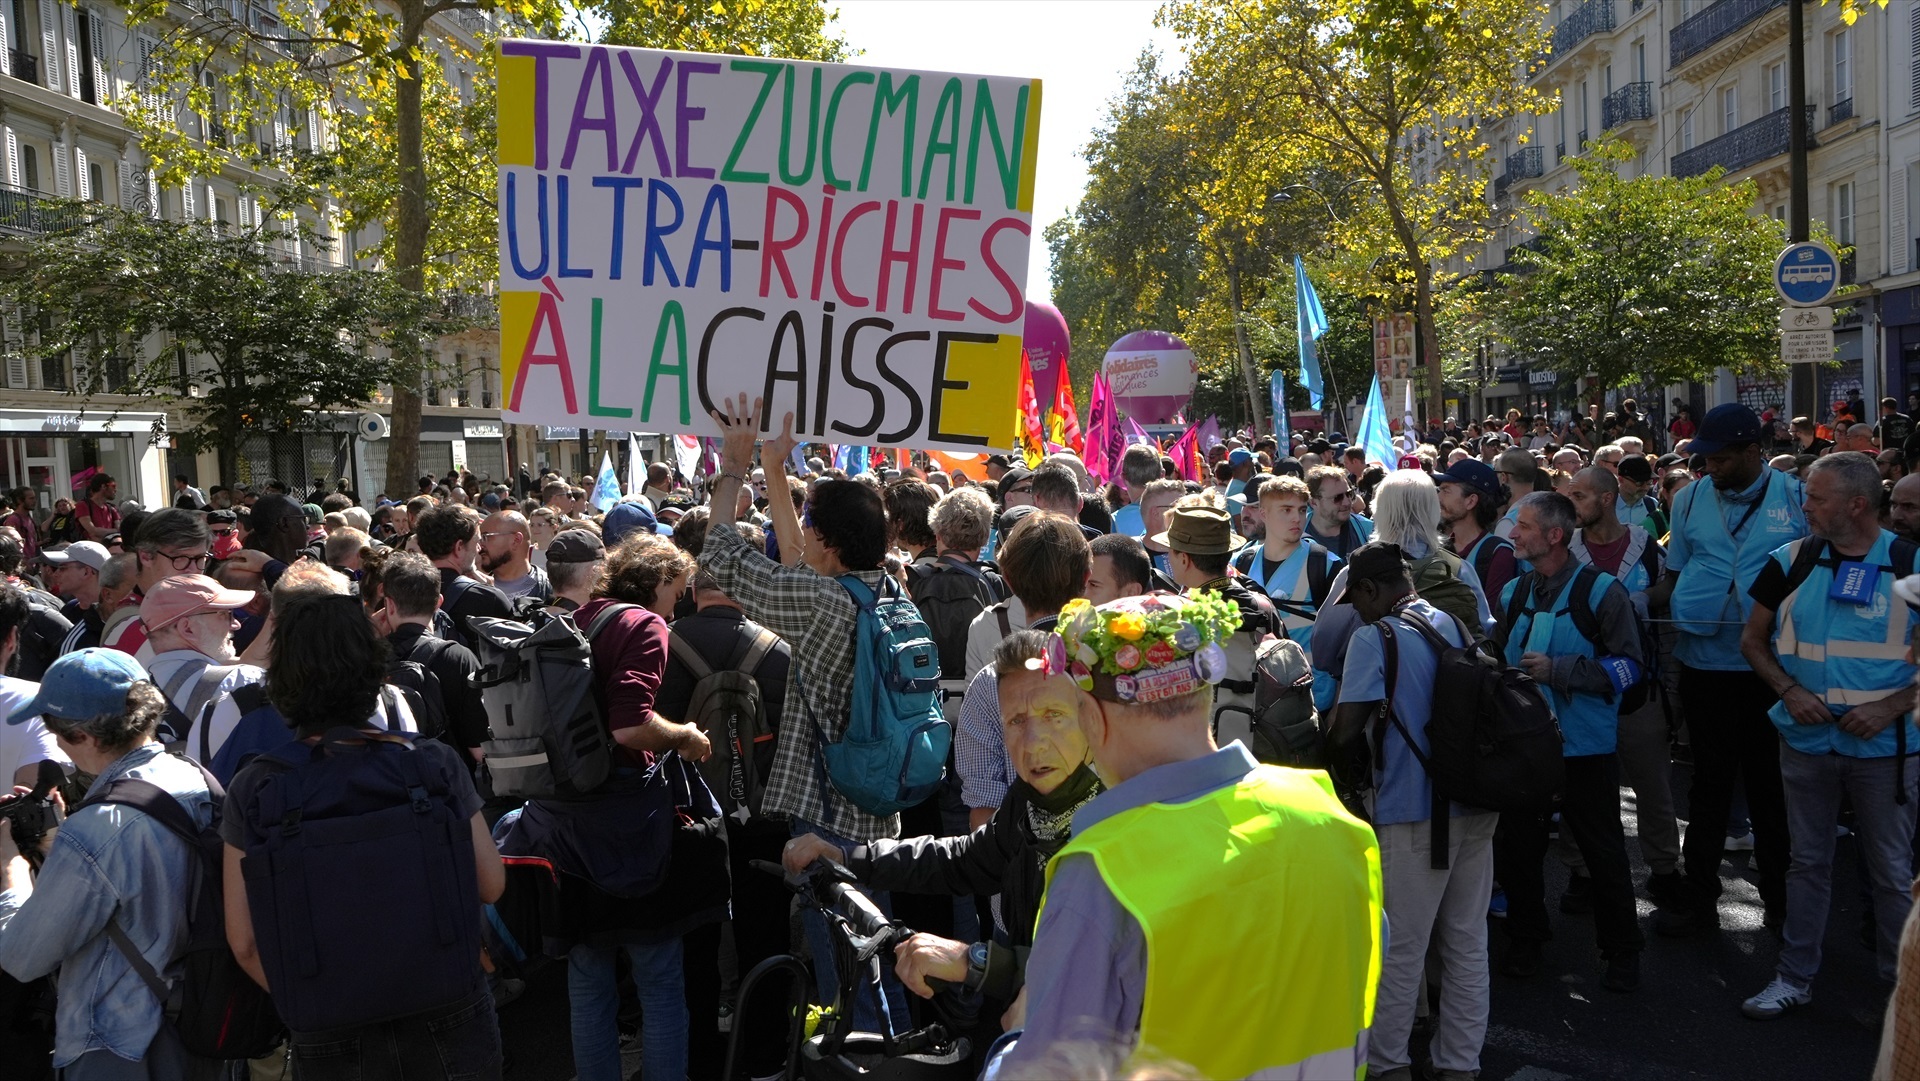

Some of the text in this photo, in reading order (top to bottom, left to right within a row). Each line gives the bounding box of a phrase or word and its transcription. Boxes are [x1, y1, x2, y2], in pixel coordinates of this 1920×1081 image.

[501, 41, 1030, 210] TAXE ZUCMAN
[508, 275, 578, 415] À
[587, 297, 691, 425] LA
[1106, 356, 1158, 375] Solidaires
[1115, 368, 1159, 383] Finances
[1841, 567, 1860, 595] L'UNSA
[1153, 669, 1190, 687] RETRAITE
[1613, 661, 1628, 688] L'UNSA
[1163, 686, 1174, 697] 60
